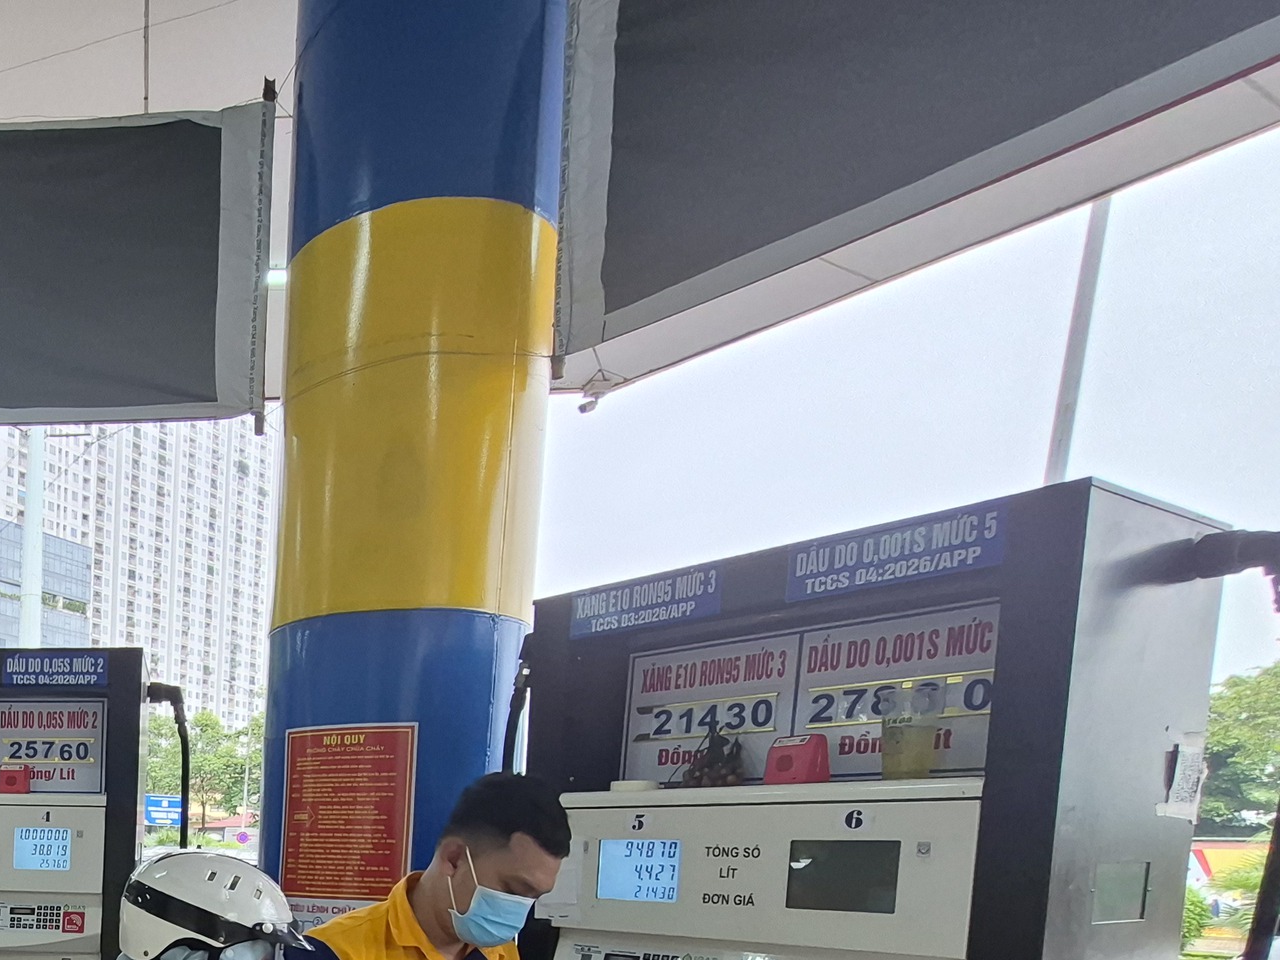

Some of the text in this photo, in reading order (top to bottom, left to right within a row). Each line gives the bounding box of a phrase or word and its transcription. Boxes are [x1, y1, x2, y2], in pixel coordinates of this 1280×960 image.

[834, 542, 857, 570] DO
[862, 526, 926, 565] 0,001S
[931, 512, 979, 549] MỨC
[984, 511, 998, 539] 5
[805, 546, 981, 594] TCCS 04:2026/APP
[609, 588, 630, 612] E10
[632, 578, 673, 608] RON95
[675, 568, 705, 600] MỨC
[707, 569, 716, 593] 3
[591, 601, 695, 632] TCCS 03:2026/APP
[846, 638, 871, 668] DO
[875, 628, 940, 667] 0,001S
[946, 616, 994, 657] MỨC
[28, 658, 41, 673] DO
[43, 658, 70, 675] 0,05S
[72, 655, 95, 673] MỨC
[97, 658, 104, 673] 2
[674, 662, 697, 689] E10
[699, 655, 741, 687] RON95
[743, 647, 775, 682] MỨC
[777, 650, 787, 678] 3
[12, 674, 97, 685] TCCS 04:2026/APP
[22, 711, 34, 728] DO
[38, 711, 64, 730] 0,05S
[67, 707, 89, 729] MỨC
[91, 711, 98, 729] 2
[652, 698, 773, 736] 21430
[323, 734, 366, 747] NỘI QUY
[933, 727, 952, 750] ít
[9, 740, 89, 761] 25760
[30, 766, 76, 781] ồng/ Lít
[631, 814, 645, 831] 5
[844, 809, 863, 829] 6
[624, 841, 678, 859] 94870
[705, 844, 761, 859] TỔNG SỐ
[634, 864, 676, 881] 4.427
[719, 867, 738, 879] LÍT
[634, 885, 675, 900] 21430
[702, 892, 755, 906] ĐƠN GIÁ
